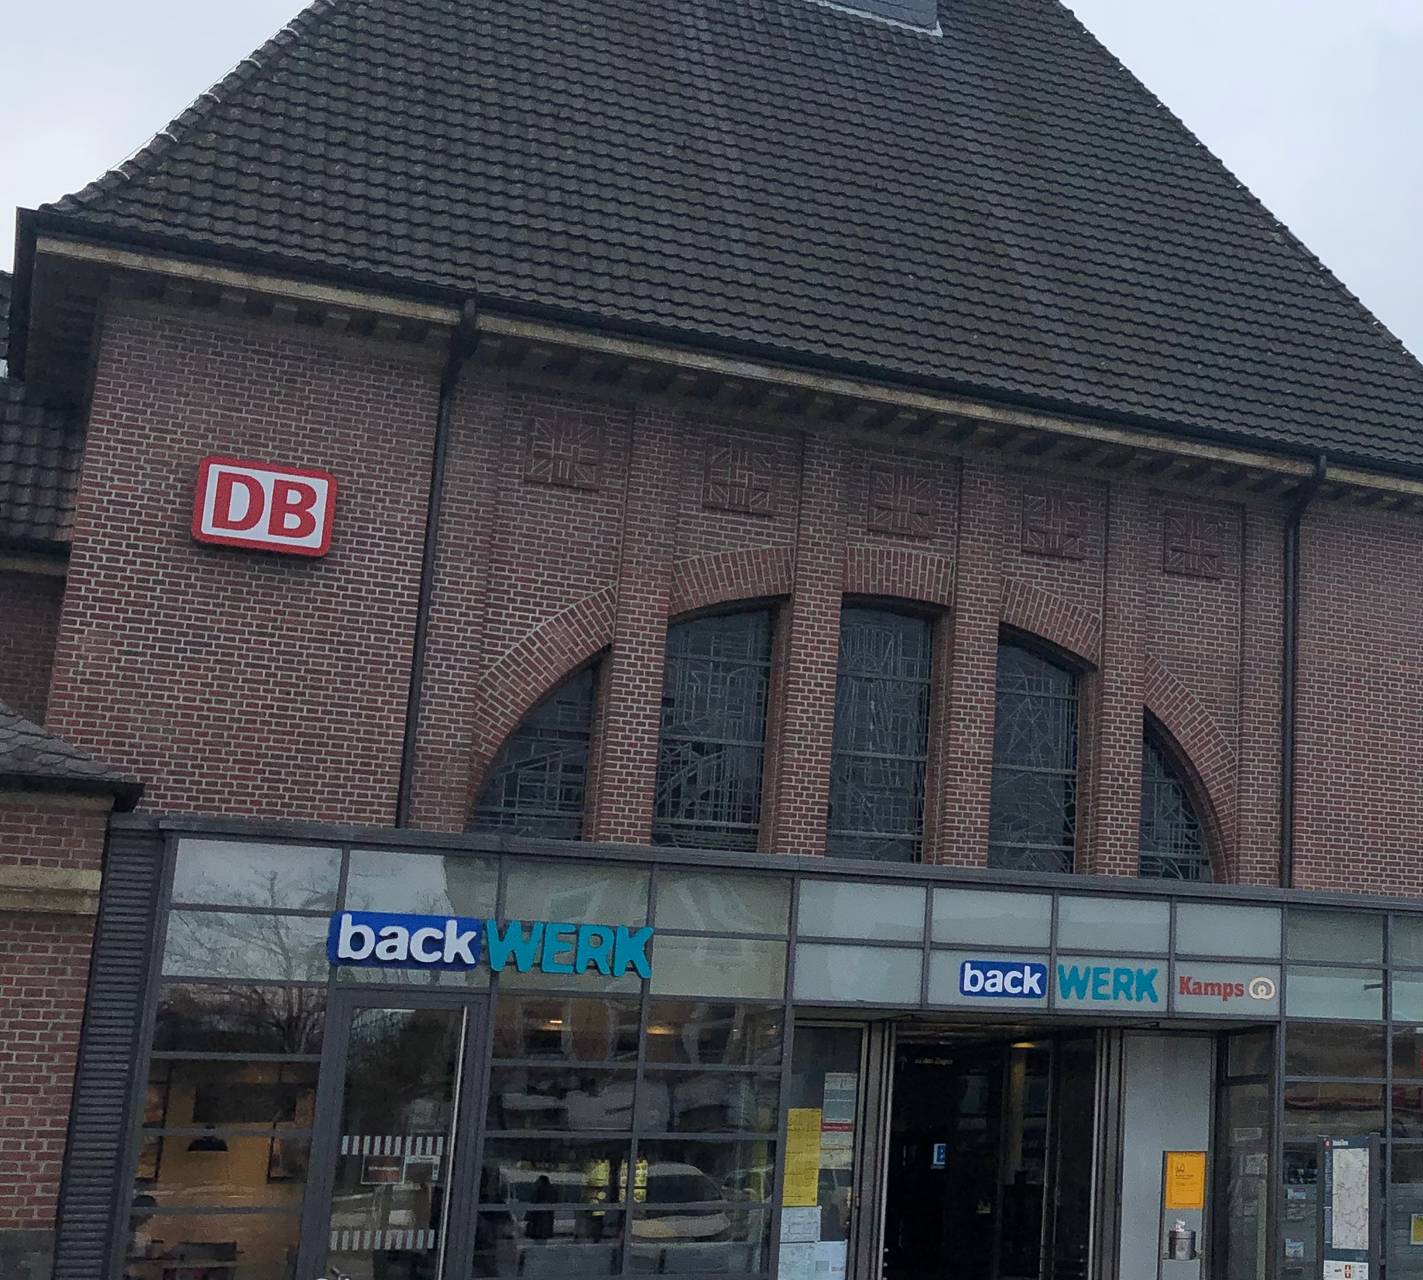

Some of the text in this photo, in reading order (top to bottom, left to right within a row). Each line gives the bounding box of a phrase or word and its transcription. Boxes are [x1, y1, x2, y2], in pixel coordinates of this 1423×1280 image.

[212, 471, 317, 538] DB
[338, 913, 653, 978] back WERK
[963, 963, 1159, 1003] back WERK
[1178, 976, 1244, 1001] Kamps
